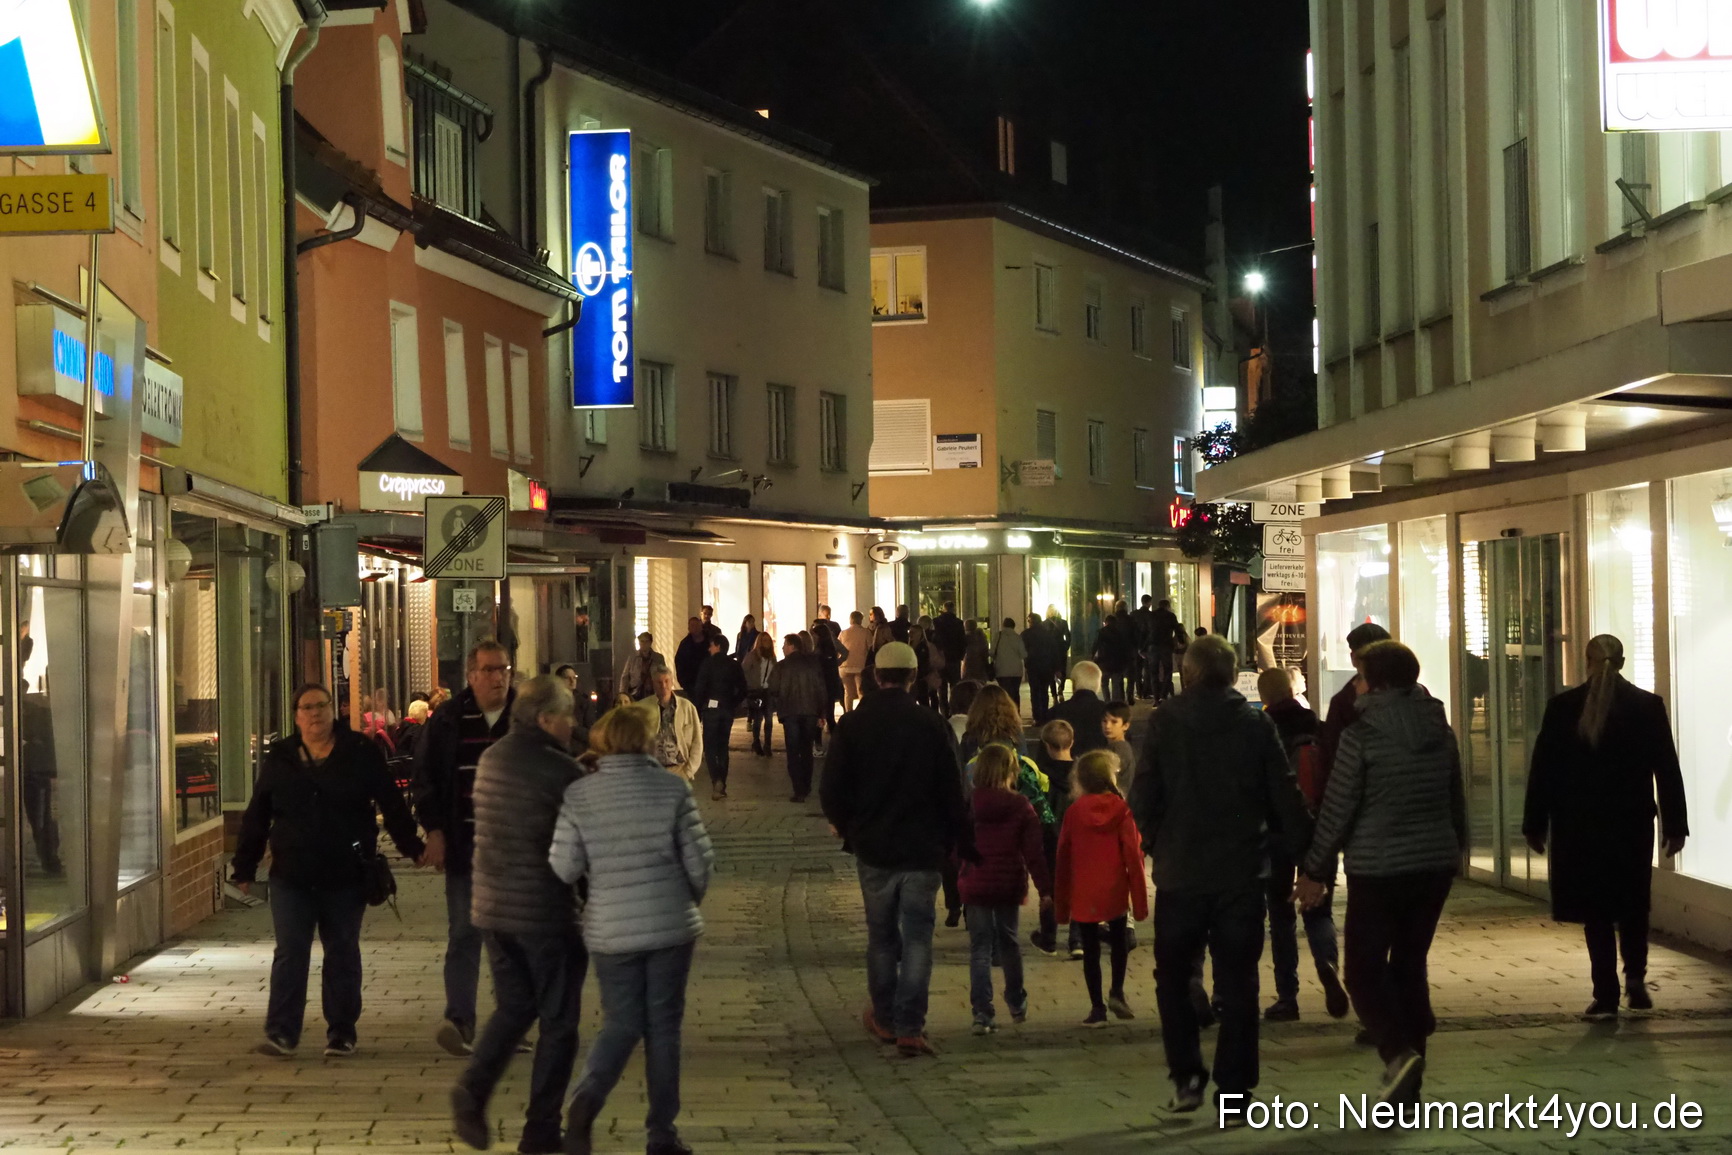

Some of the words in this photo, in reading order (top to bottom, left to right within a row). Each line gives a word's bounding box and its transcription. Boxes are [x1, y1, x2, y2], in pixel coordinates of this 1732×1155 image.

[0, 191, 74, 215] GASSE
[85, 191, 97, 213] 4
[609, 153, 627, 284] TAILOR
[611, 287, 629, 383] TOM
[379, 473, 446, 502] Creppresso
[304, 509, 321, 517] asse
[1270, 503, 1305, 516] ZONE
[1279, 545, 1295, 554] frei
[445, 558, 484, 571] ZONE
[1269, 563, 1304, 571] Lieferverkehr
[1267, 571, 1290, 580] werktags
